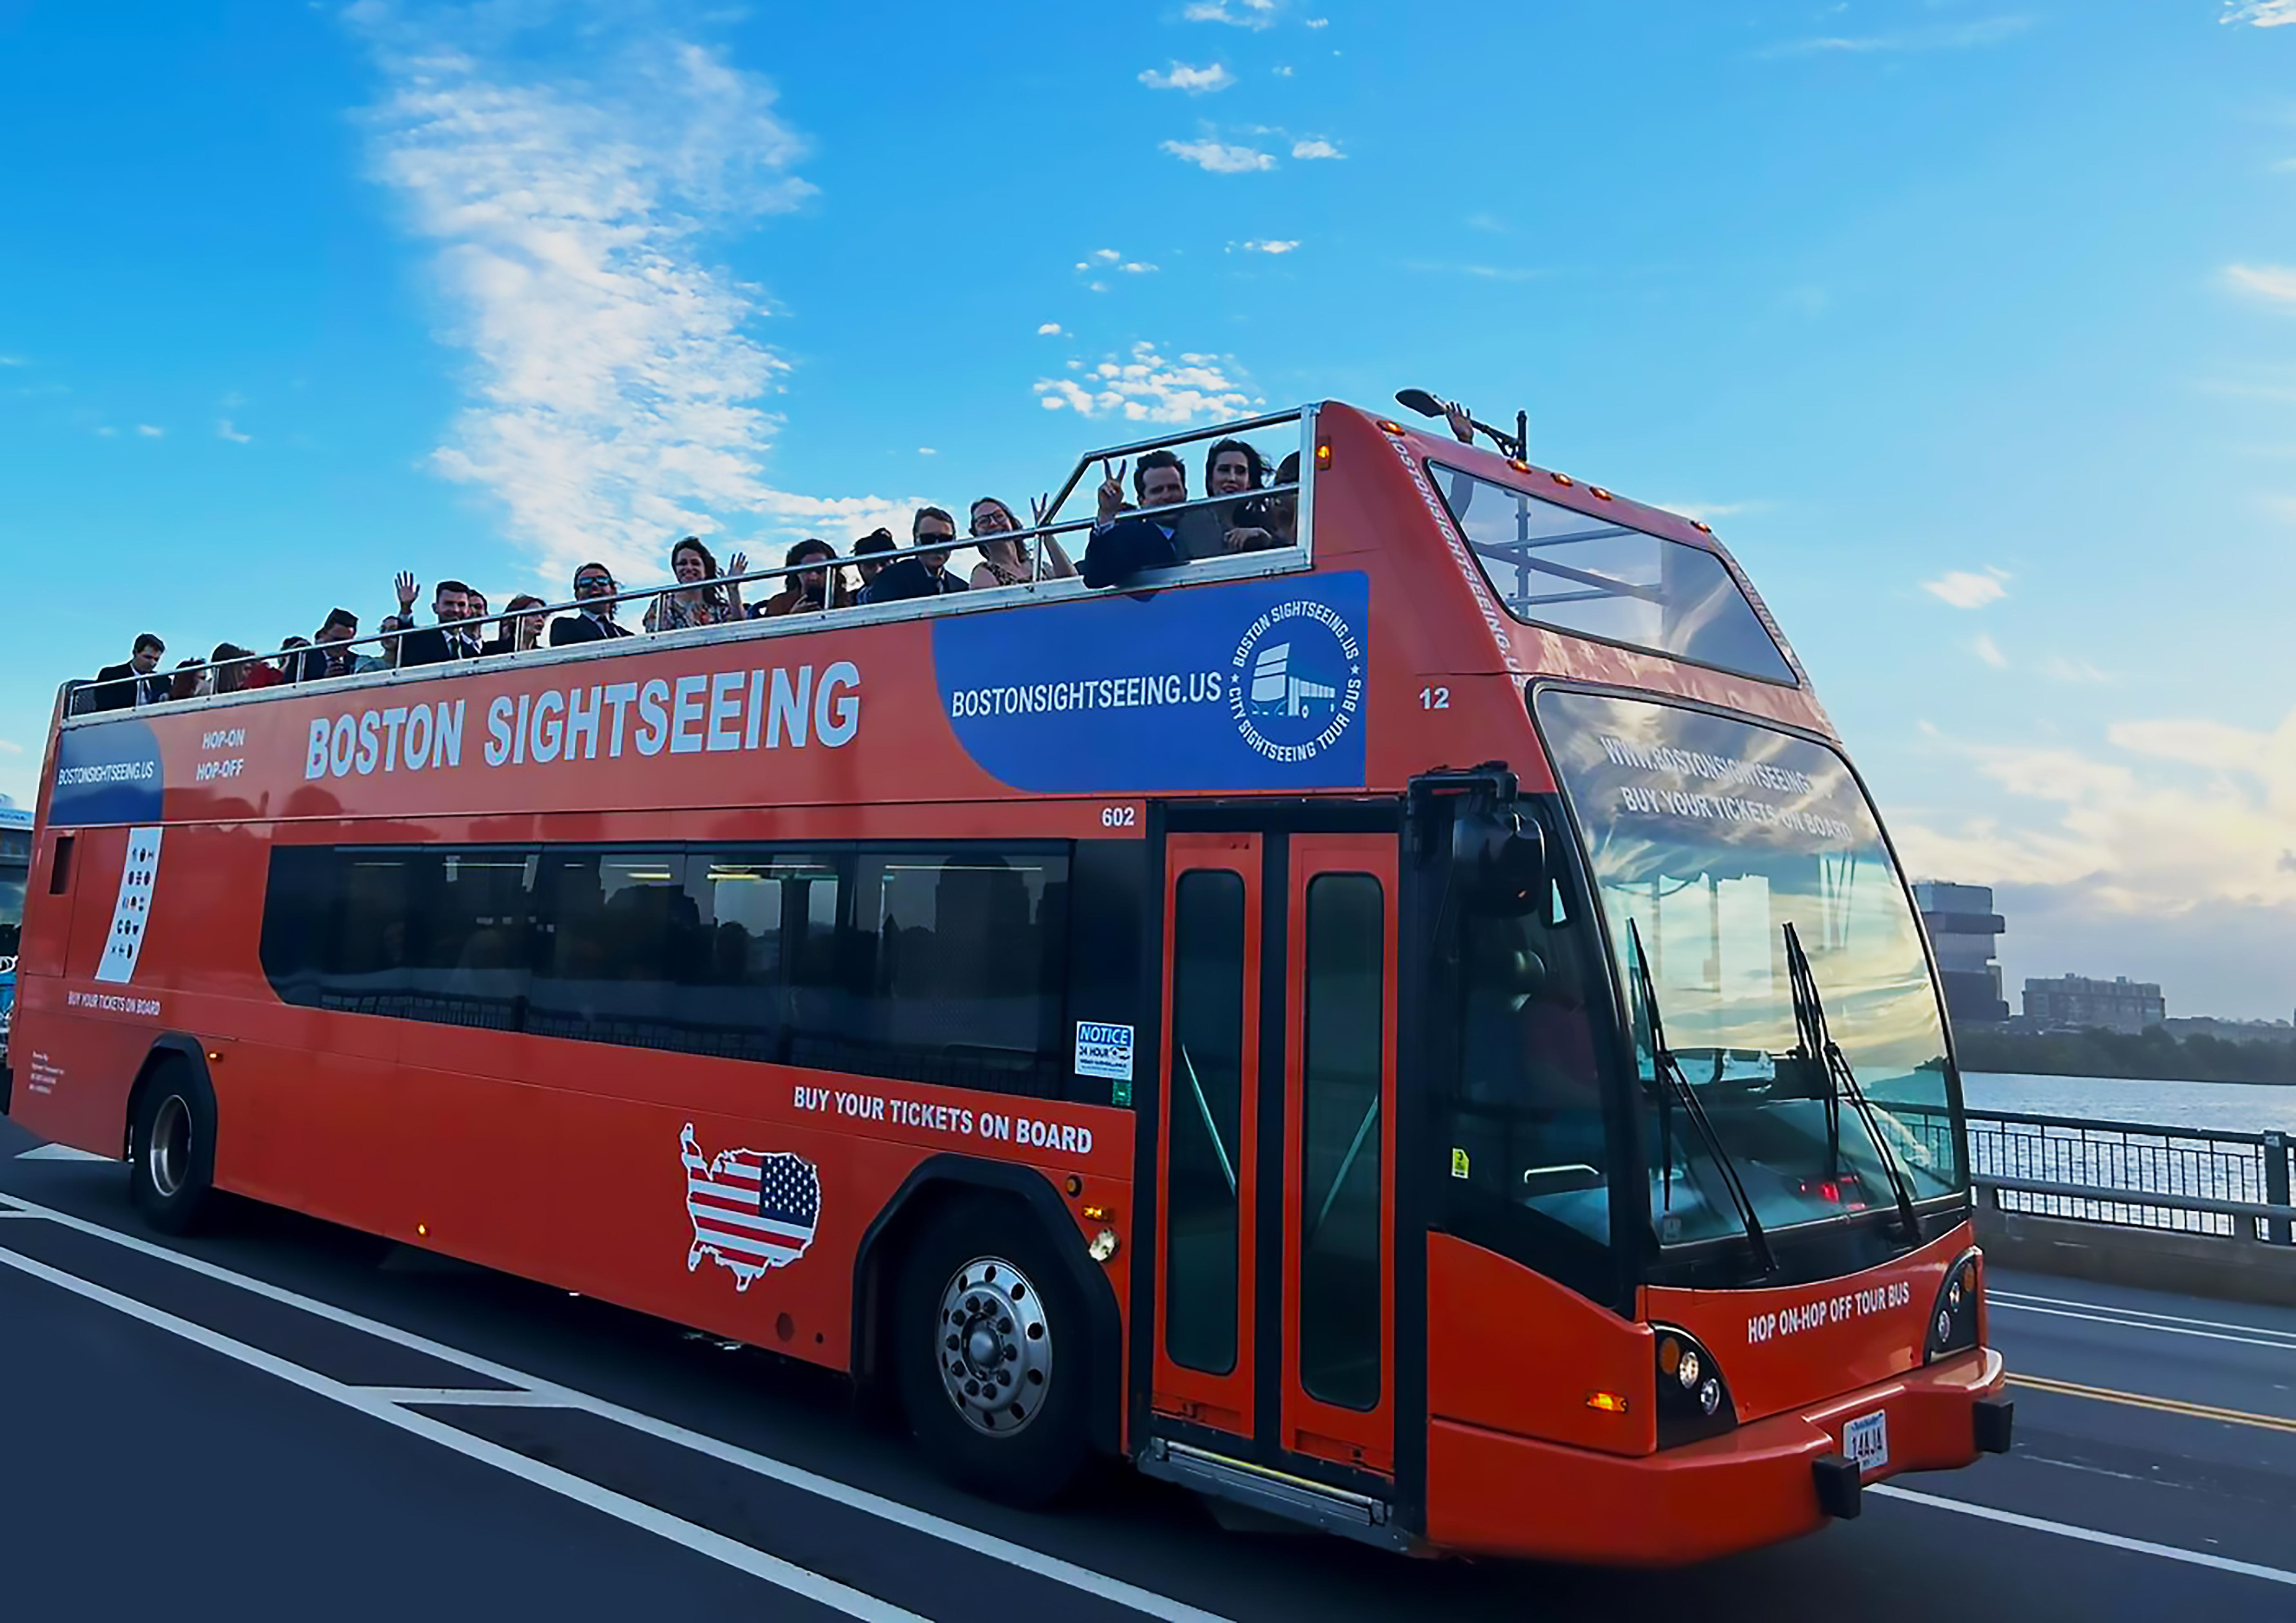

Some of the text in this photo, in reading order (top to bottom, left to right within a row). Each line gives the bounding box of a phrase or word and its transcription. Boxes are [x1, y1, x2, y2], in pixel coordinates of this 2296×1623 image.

[1233, 601, 1359, 667] BOSTON SIGHTSEEING.US
[952, 671, 1222, 718] BOSTONSIGHTSEEING.US
[1419, 687, 1449, 709] 12
[304, 661, 860, 779] BOSTON SIGHTSEEING
[1229, 679, 1361, 762] CITY SIGHTSEEING TOUR BUS
[202, 728, 245, 749] HOP-ON
[58, 761, 154, 785] BOSTONSIGHTSEEING.US
[196, 758, 244, 781] HOP-OFF
[1102, 807, 1135, 827] 602
[1620, 787, 1853, 841] BUY YOUR TICKETS ON BOARD
[99, 995, 125, 1011] TICKETS
[136, 999, 161, 1016] BOARD
[1080, 1026, 1128, 1044] NOTICE
[794, 1085, 1093, 1154] BUY YOUR TICKETS ON BOARD
[1748, 1281, 1910, 1344] HOP ON-HOP OFF TOUR BUS
